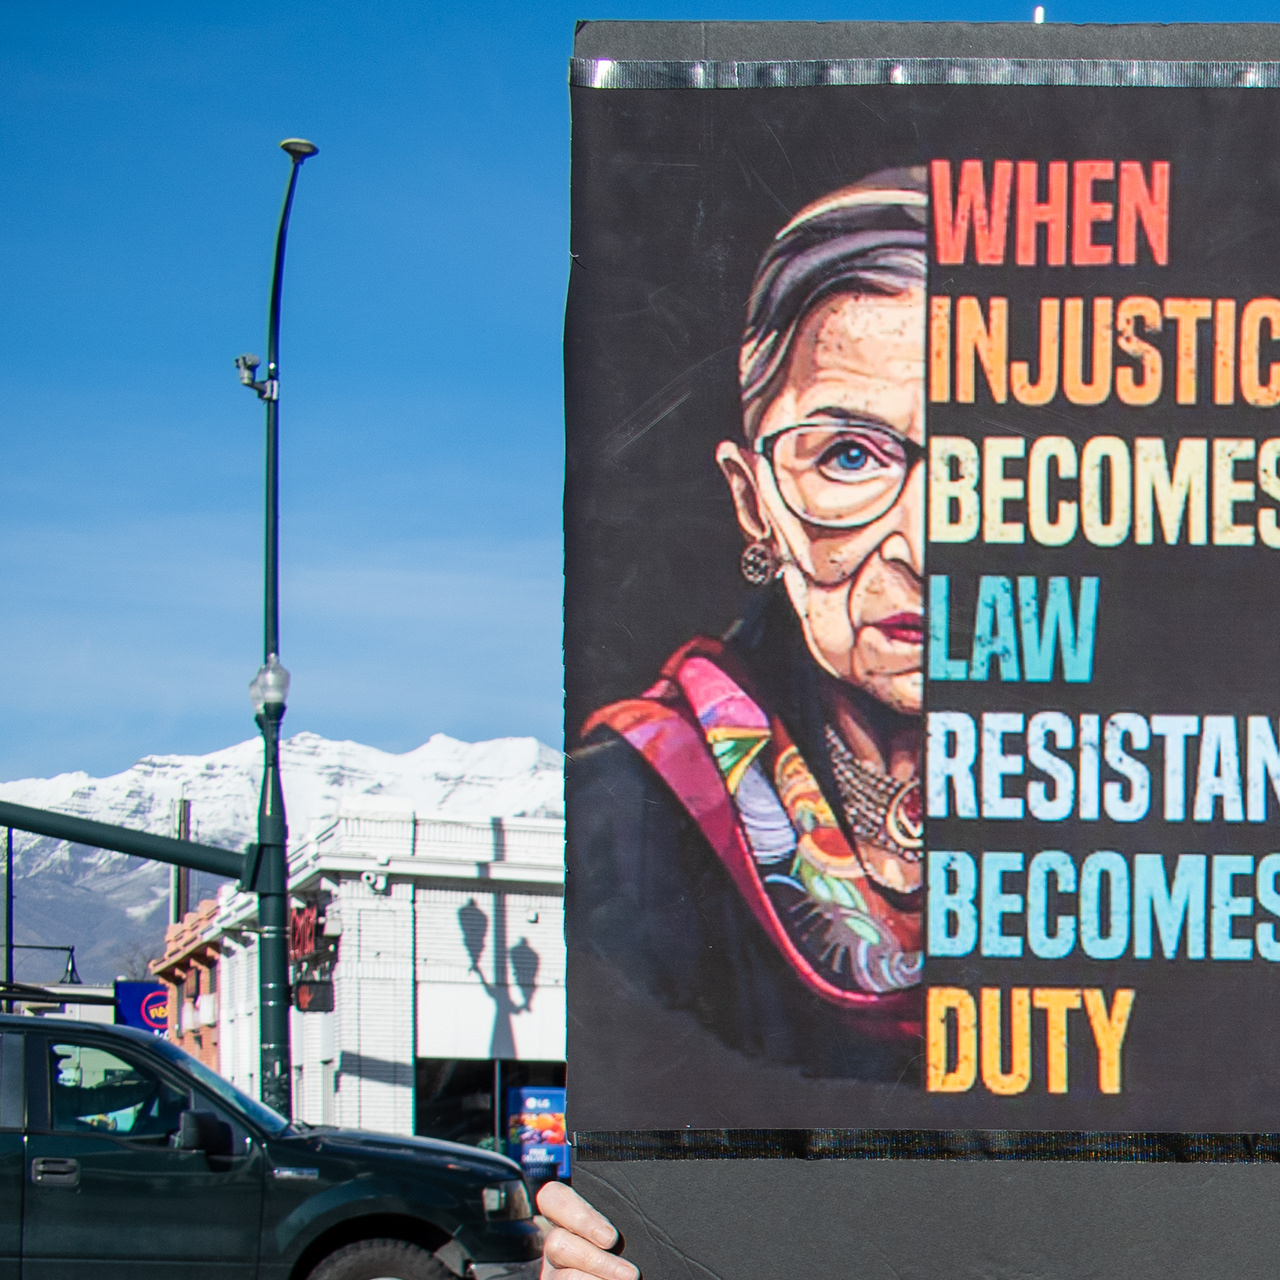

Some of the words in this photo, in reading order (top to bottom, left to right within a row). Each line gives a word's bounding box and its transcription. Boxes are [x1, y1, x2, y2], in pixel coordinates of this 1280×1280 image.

[931, 159, 1170, 266] WHEN
[929, 576, 1099, 683] LAW
[927, 987, 1135, 1095] DUTY
